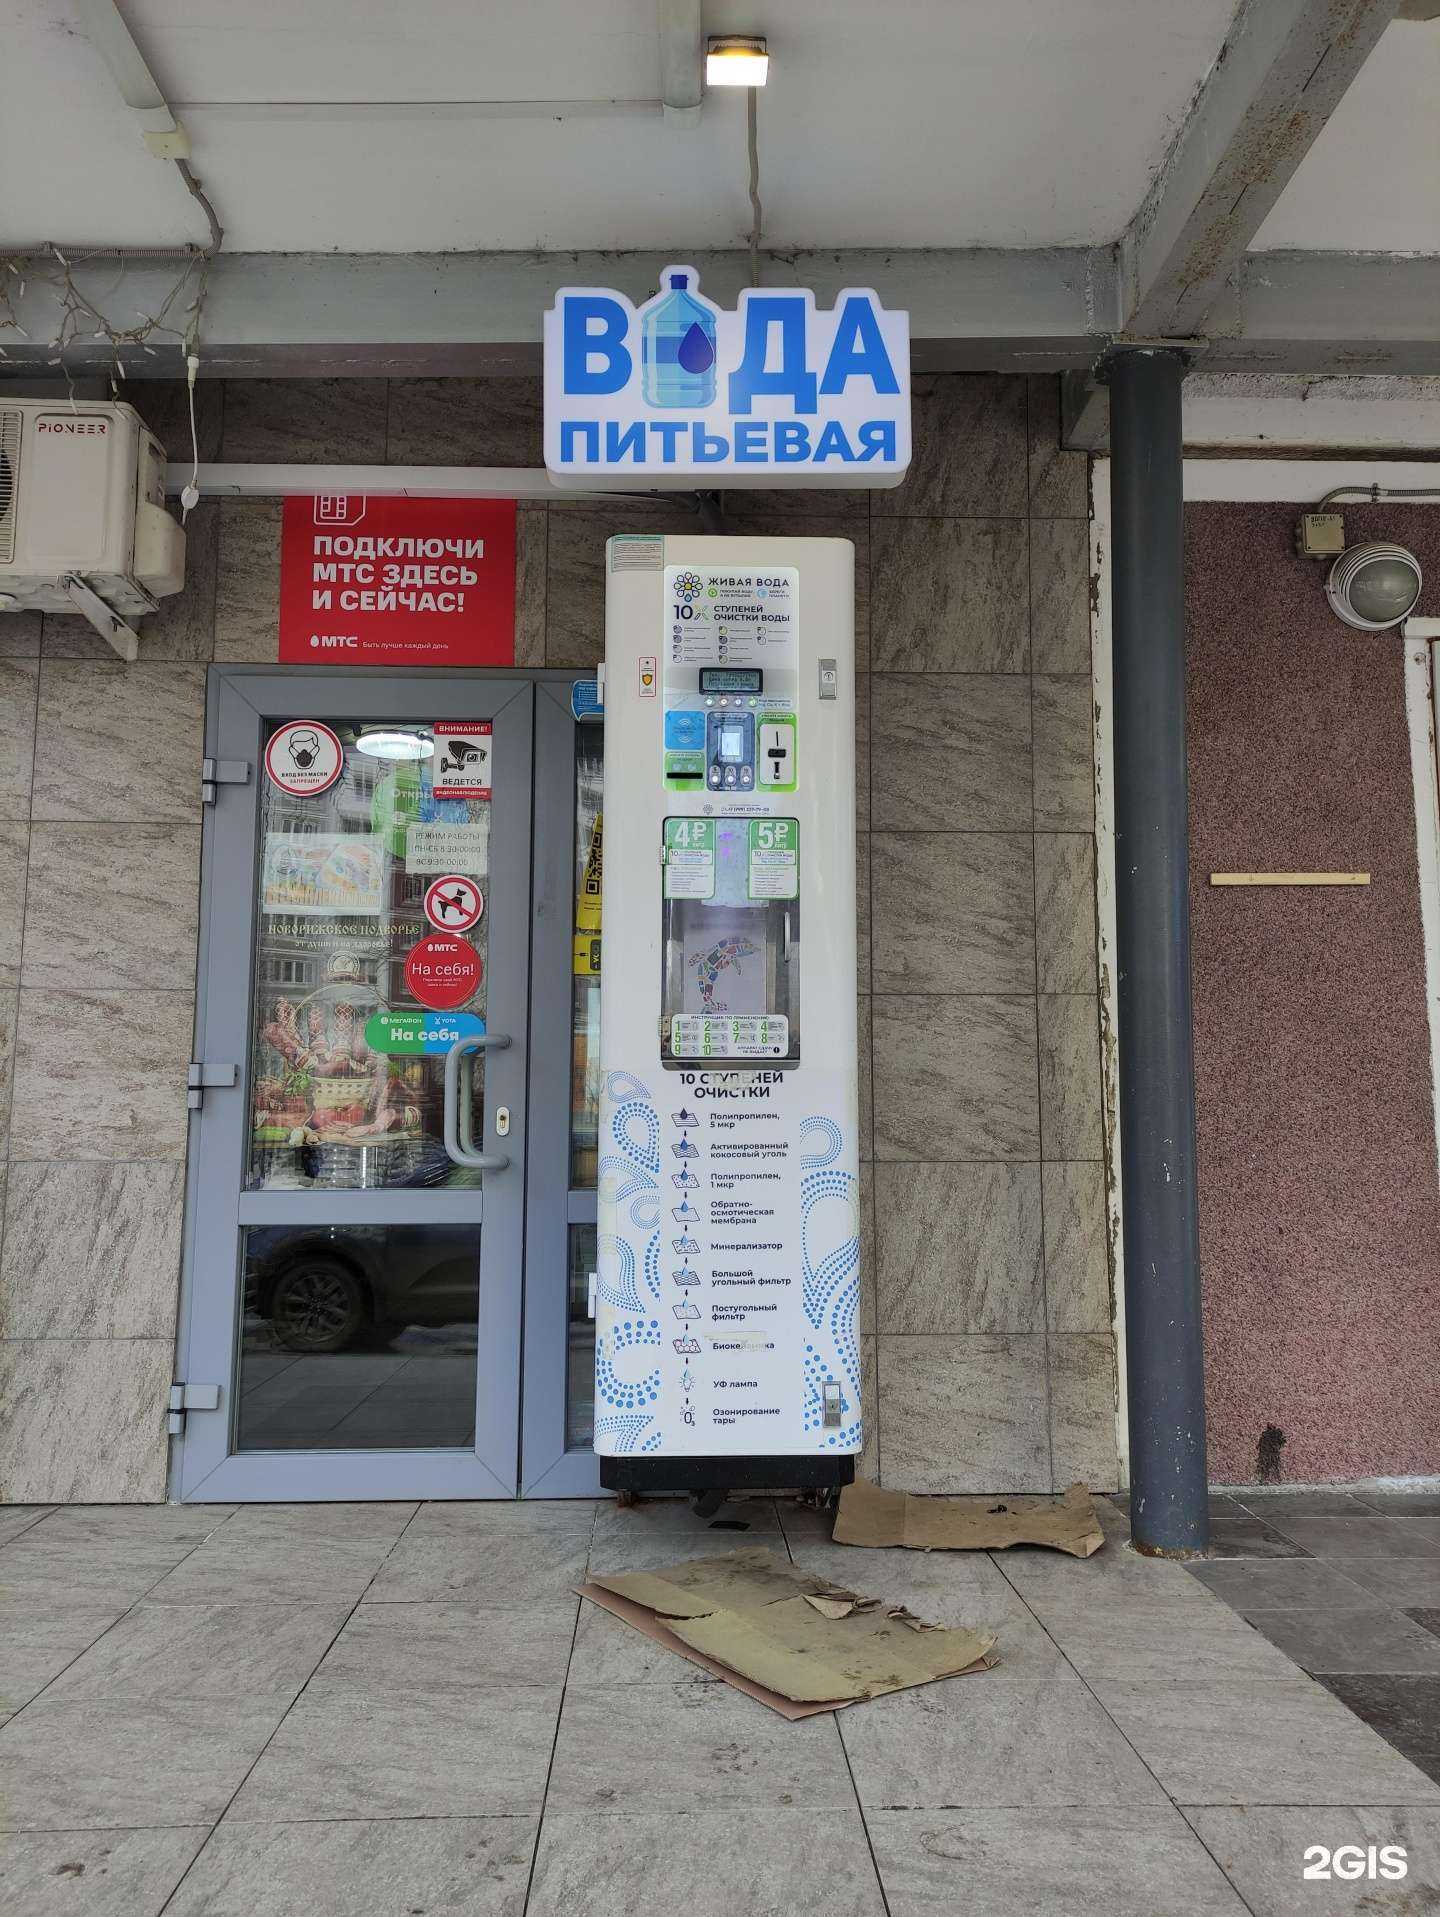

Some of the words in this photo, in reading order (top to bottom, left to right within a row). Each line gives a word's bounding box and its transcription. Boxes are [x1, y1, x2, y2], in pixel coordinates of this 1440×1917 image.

[564, 297, 900, 414] ВДА
[560, 421, 896, 462] ПИТЬЕВАЯ
[313, 535, 484, 560] ПОДКЛЮЧИ
[313, 563, 375, 583] МТС
[382, 564, 478, 588] ЗДЕСЬ
[708, 577, 752, 586] ЖИВАЯ
[756, 578, 789, 588] ВОДА
[312, 590, 332, 610] И
[340, 585, 465, 613] СЕЙЧАС!
[673, 604, 693, 620] 10
[714, 604, 763, 613] СТУПЕНЕЙ
[714, 614, 759, 622] ОЧИСТКИ
[762, 615, 790, 623] ВОДЫ
[321, 635, 358, 648] МТС
[362, 641, 380, 649] Быть
[404, 642, 432, 650] каждый
[439, 725, 488, 733] ВНИМАНИЕ!
[442, 778, 482, 786] ВЕДЕТСЯ
[415, 832, 446, 840] РЕЖИМ
[447, 832, 480, 841] РАБОТЫ
[434, 943, 458, 952] МТС
[412, 962, 431, 975] На
[435, 962, 474, 976] себя!
[704, 1021, 711, 1031] 2
[732, 1021, 739, 1031] 3
[760, 1021, 768, 1032] 4
[390, 1028, 414, 1041] На
[417, 1028, 459, 1041] себя
[674, 1032, 681, 1043] 5
[704, 1032, 711, 1043] 6
[733, 1032, 740, 1043] 7
[761, 1033, 768, 1043] 8
[674, 1044, 681, 1055] 9
[702, 1044, 711, 1055] 10
[680, 1073, 696, 1085] 10
[694, 1086, 770, 1099] ОЧИСТКИ
[710, 1112, 780, 1122] Полипропилен,
[717, 1121, 736, 1129] мкр
[710, 1142, 789, 1151] Активированный
[710, 1150, 760, 1159] кокосовый
[762, 1150, 787, 1160] уголь
[710, 1173, 781, 1182] Полипропилен,
[716, 1181, 735, 1190] мкр
[710, 1201, 753, 1209] Обратно-
[710, 1209, 775, 1217] осмотическая
[710, 1216, 757, 1225] мембрана
[710, 1242, 783, 1251] Минерализатор
[711, 1269, 753, 1278] Большой
[711, 1277, 756, 1288] угольный
[757, 1277, 792, 1287] фильтр
[711, 1304, 778, 1314] Постугольный
[711, 1312, 746, 1321] фильтр
[712, 1342, 775, 1350] Биокека
[713, 1380, 728, 1388] УФ
[729, 1381, 758, 1389] лампа
[712, 1408, 781, 1416] Озонирование
[712, 1417, 736, 1426] тары
